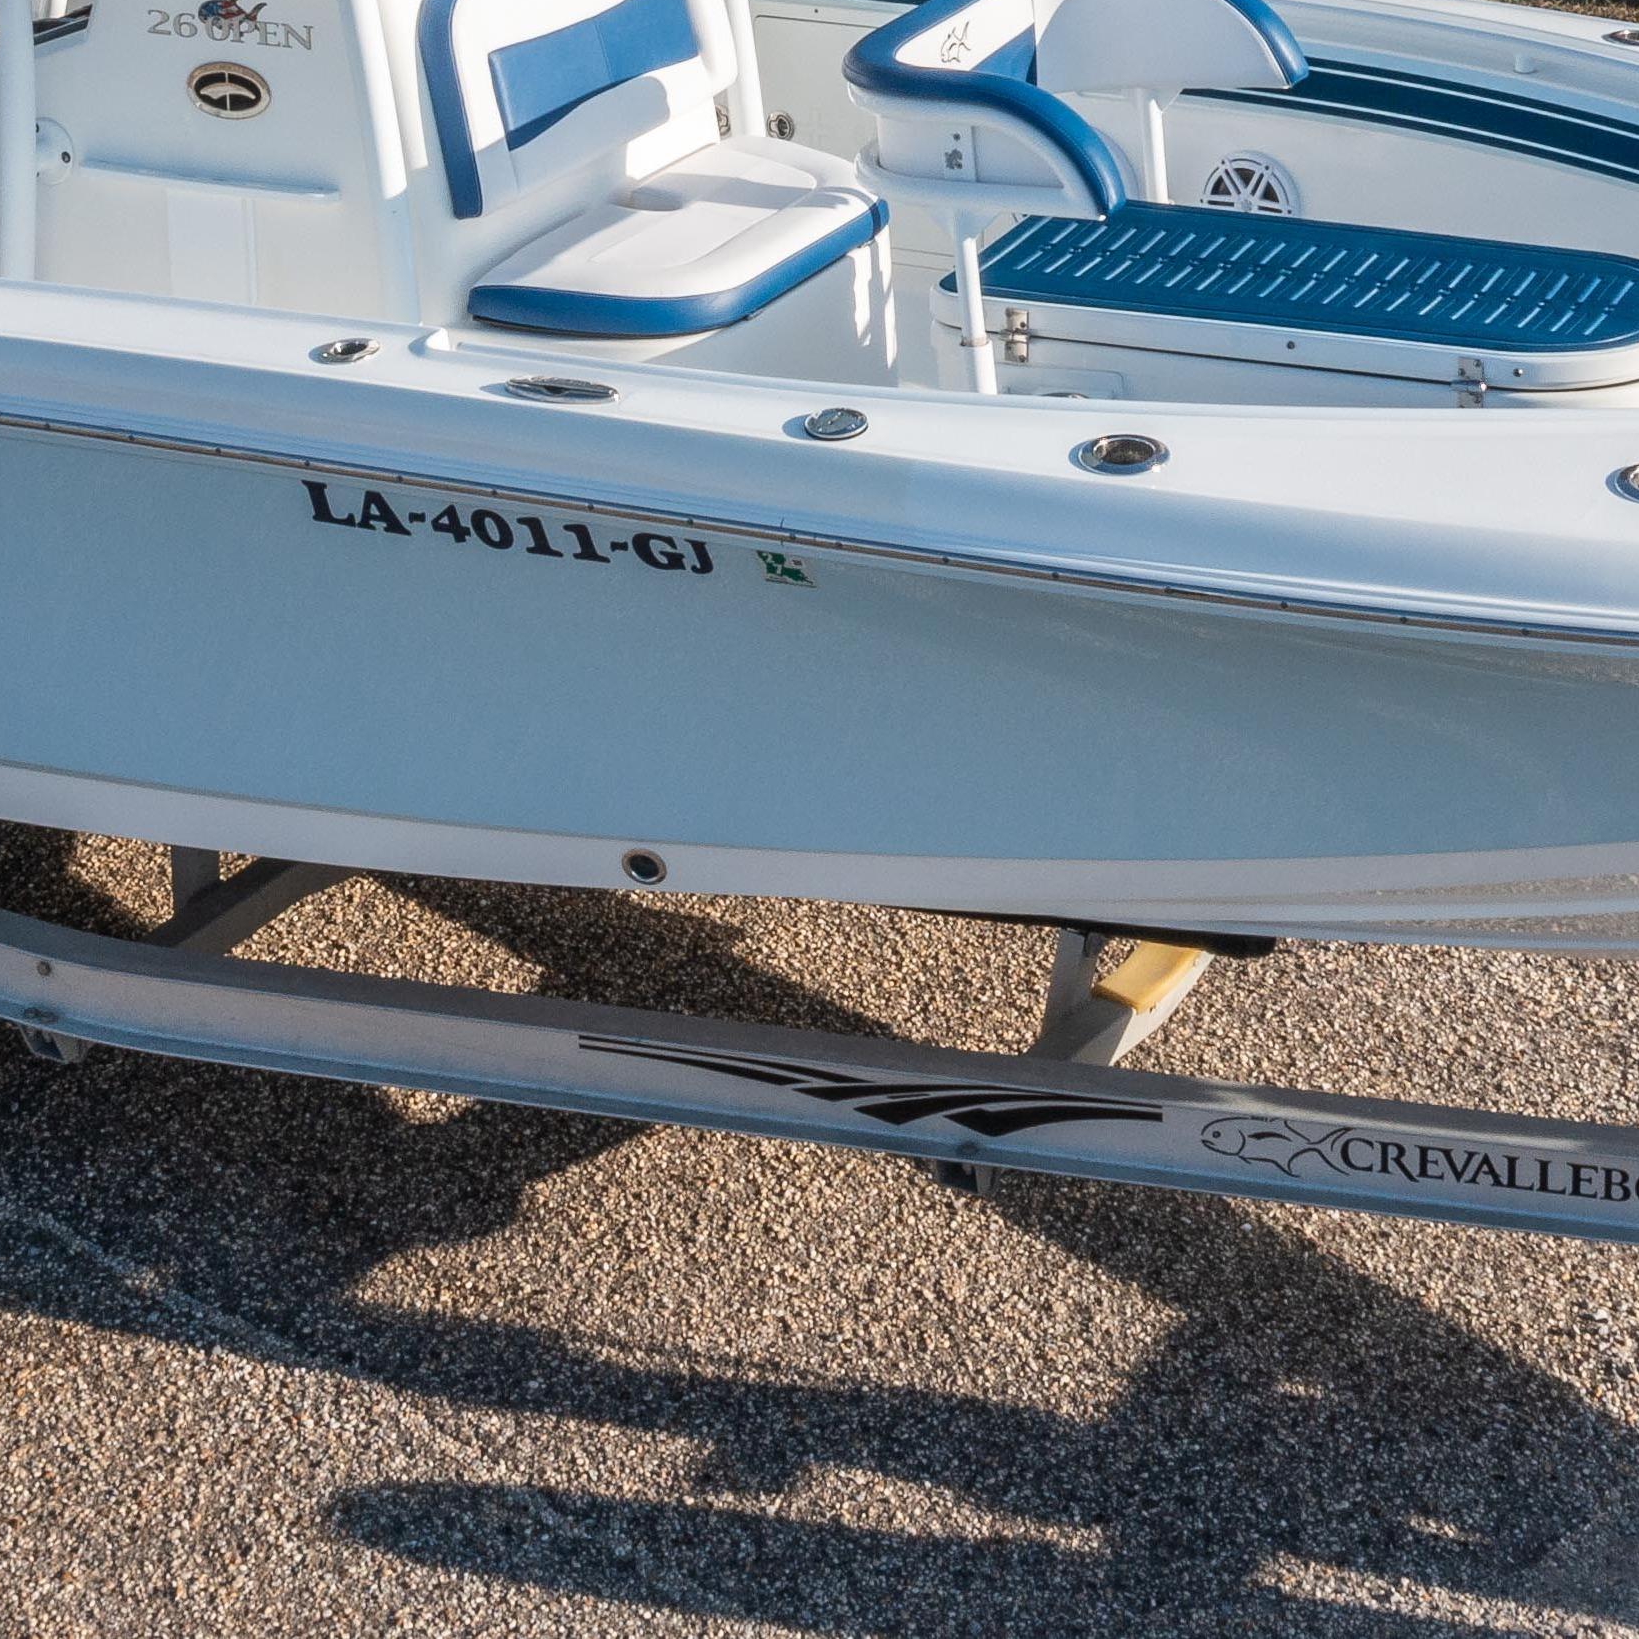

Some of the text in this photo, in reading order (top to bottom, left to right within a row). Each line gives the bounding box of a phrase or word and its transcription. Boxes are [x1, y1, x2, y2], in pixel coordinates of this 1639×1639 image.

[147, 9, 314, 51] 26 OPEN
[301, 479, 714, 575] LA-4011-GJ
